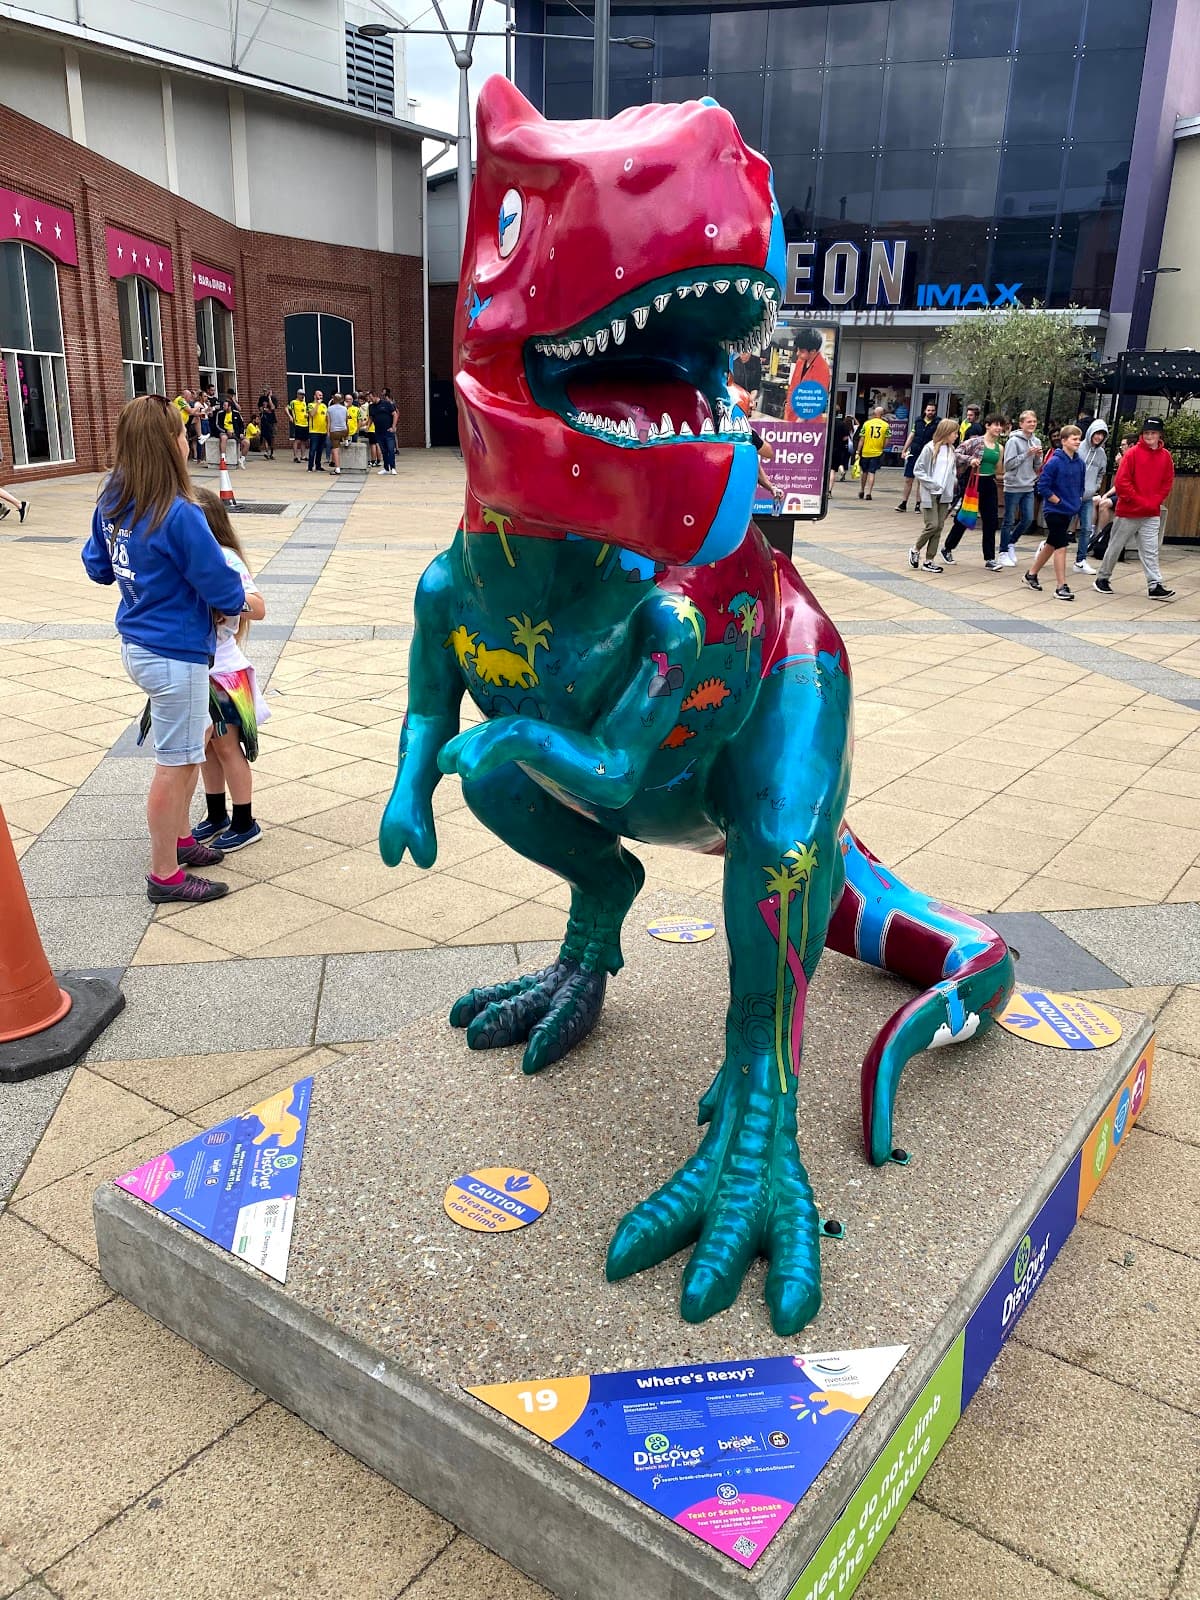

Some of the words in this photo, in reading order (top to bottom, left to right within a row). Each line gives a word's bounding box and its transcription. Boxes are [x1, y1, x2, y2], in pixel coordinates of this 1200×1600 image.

[784, 241, 907, 305] EON
[916, 283, 1023, 307] IMAX
[760, 427, 823, 447] Journey
[870, 426, 882, 439] 13
[774, 449, 815, 465] Here
[1034, 1000, 1081, 1040] CAUTION
[1076, 1002, 1100, 1023] climb
[1095, 1022, 1115, 1035] not
[257, 1148, 280, 1190] Discover
[468, 1183, 527, 1216] CAUTION
[448, 1202, 468, 1214] not
[467, 1211, 497, 1229] climb
[492, 1212, 507, 1223] do
[1002, 1232, 1050, 1327] Discover
[636, 1372, 704, 1389] Where's
[706, 1367, 756, 1383] Rexy?
[516, 1388, 559, 1414] 19
[717, 1435, 756, 1450] break
[633, 1446, 705, 1466] Discover
[859, 1494, 878, 1531] do
[881, 1450, 905, 1498] not
[907, 1395, 941, 1455] climb
[688, 1511, 706, 1519] Text
[719, 1507, 740, 1516] Scan
[740, 1506, 750, 1514] to
[751, 1503, 783, 1512] Donate
[838, 1543, 865, 1593] the
[867, 1436, 931, 1547] sculpture
